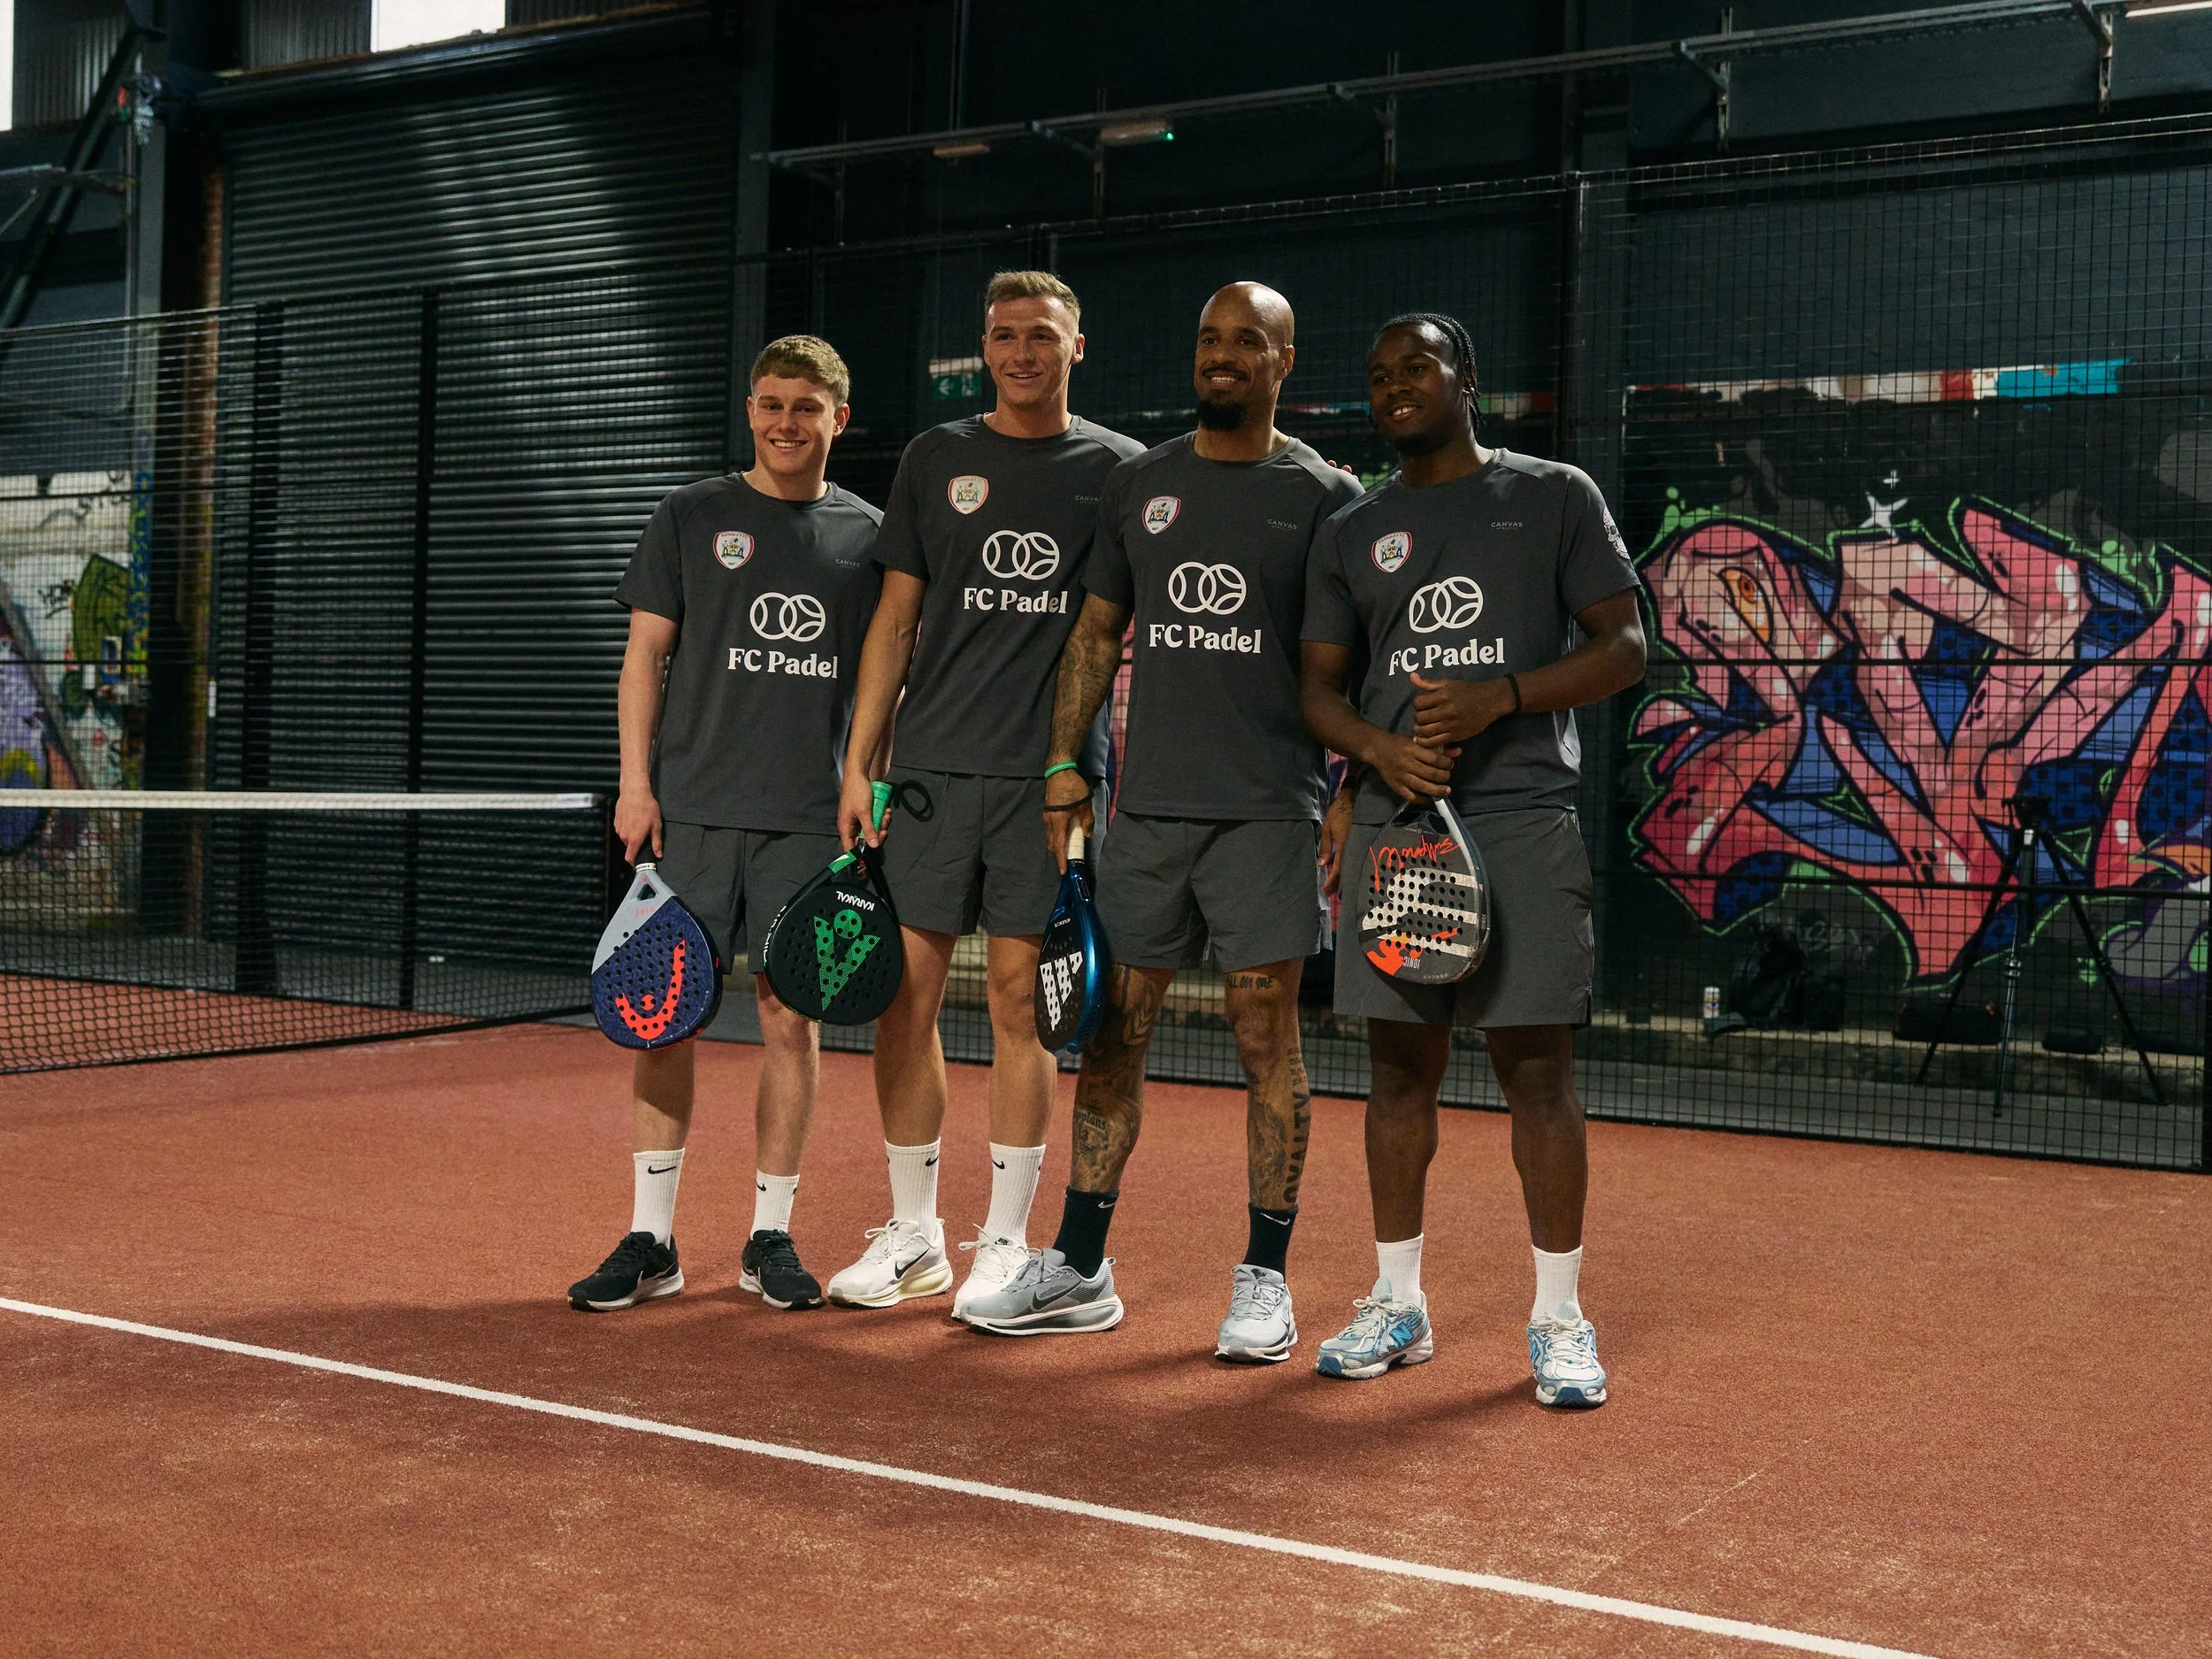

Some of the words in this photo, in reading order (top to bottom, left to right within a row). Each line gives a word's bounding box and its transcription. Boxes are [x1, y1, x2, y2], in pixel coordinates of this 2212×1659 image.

[1267, 518, 1298, 529] CANVAS
[964, 587, 994, 611] FC
[1000, 589, 1067, 614] Padel
[1149, 624, 1183, 649] FC
[1189, 626, 1262, 654] Padel
[728, 648, 761, 672] FC
[767, 650, 838, 679] Padel
[1388, 647, 1419, 676] FC
[1424, 637, 1505, 669] Padel
[835, 890, 875, 911] KARAKAL
[1402, 955, 1421, 970] IONIC
